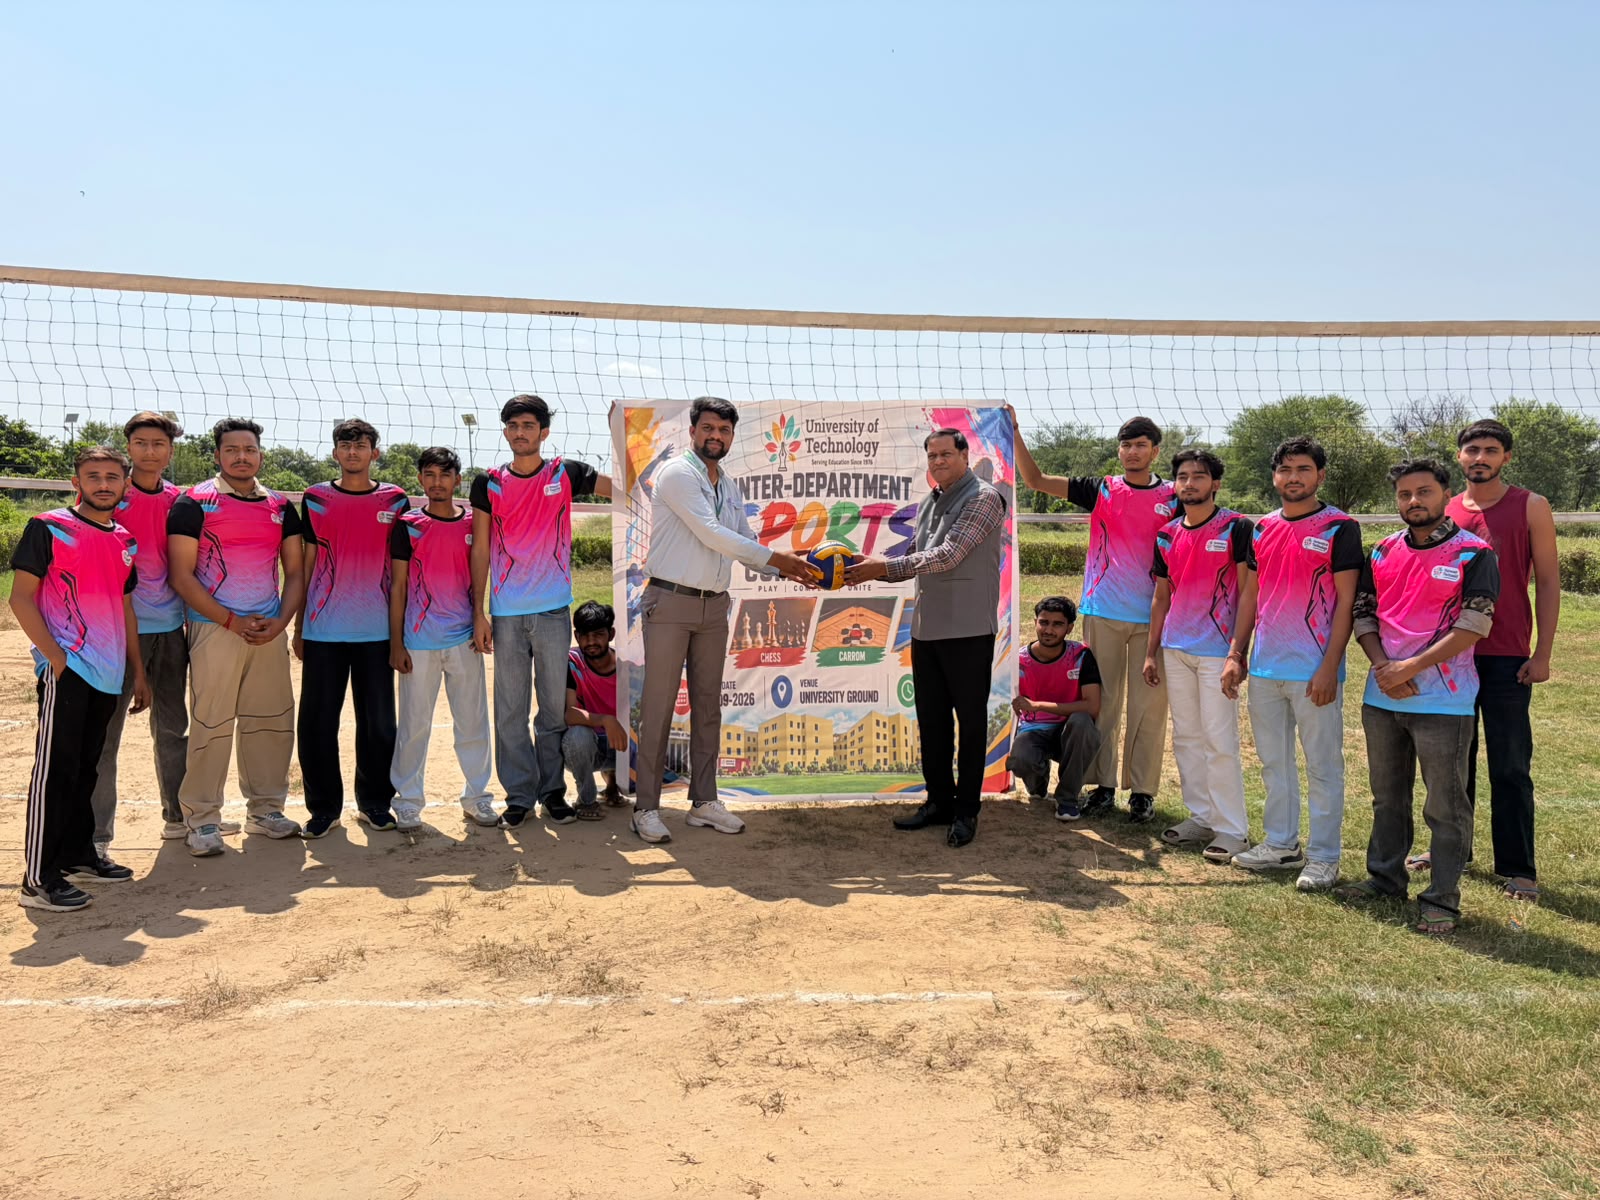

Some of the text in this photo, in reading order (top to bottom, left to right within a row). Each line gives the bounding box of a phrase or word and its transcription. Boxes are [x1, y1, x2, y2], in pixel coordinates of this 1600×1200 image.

[805, 418, 880, 437] University of
[805, 436, 880, 457] Technology
[733, 472, 913, 501] NTER-DEPARTMENT
[847, 584, 872, 592] UNITE
[760, 651, 866, 663] CHESS CARROM
[721, 679, 818, 690] DATE VENUE
[799, 690, 845, 704] UNIVERSITY
[846, 690, 879, 703] GROUND
